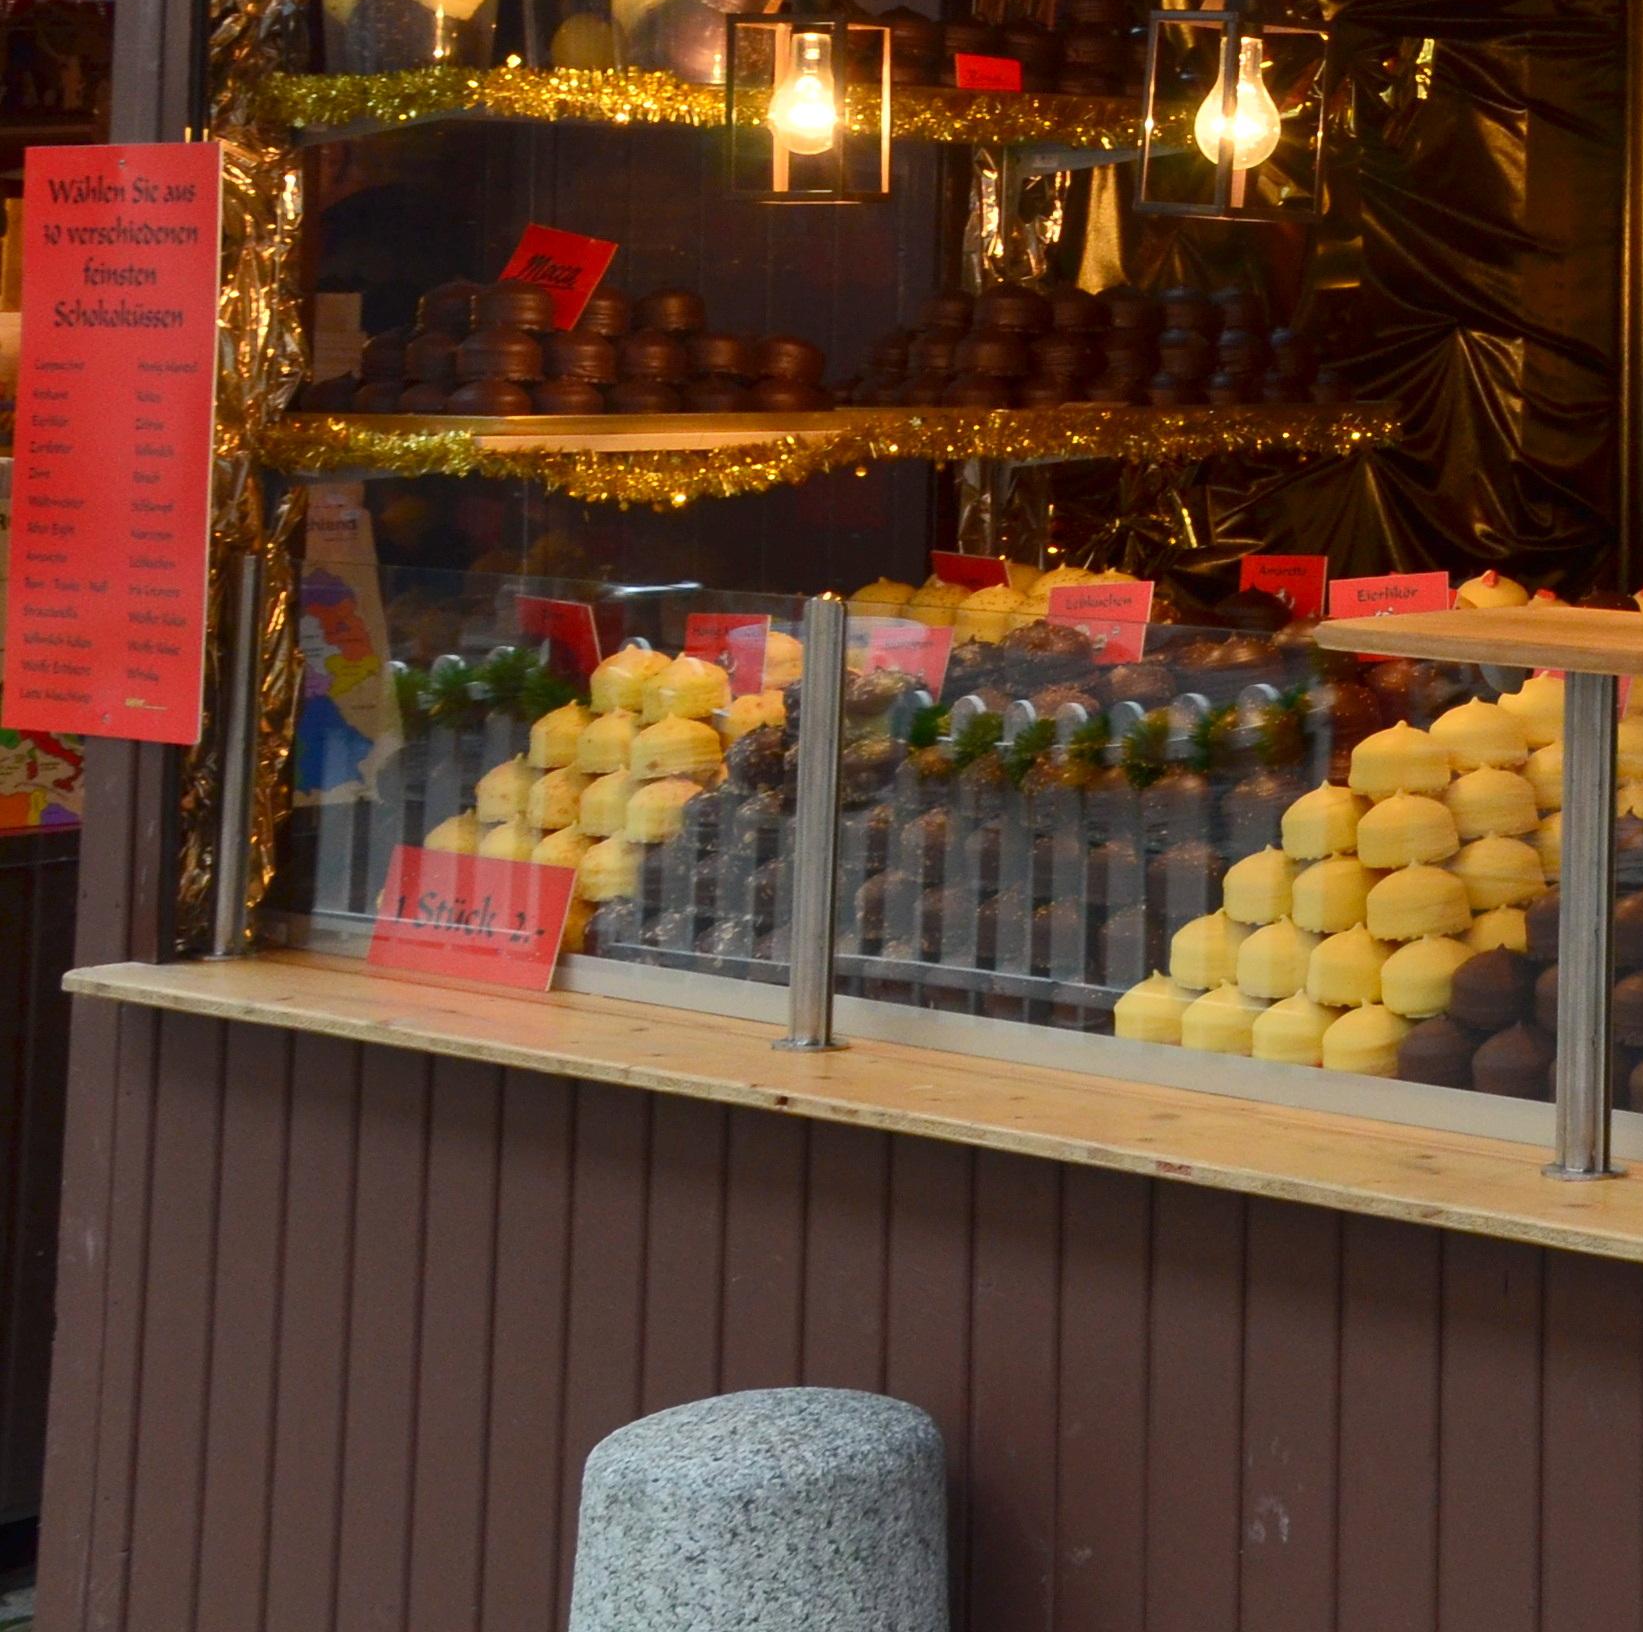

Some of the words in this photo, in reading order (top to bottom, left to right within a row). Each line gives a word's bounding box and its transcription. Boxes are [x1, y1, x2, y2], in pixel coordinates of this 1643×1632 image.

[48, 175, 126, 204] Wählen
[132, 177, 159, 204] Sie
[163, 183, 196, 204] aus
[67, 216, 199, 245] verschiedenen
[83, 256, 157, 287] feinsten
[53, 298, 184, 328] Schokoküssen
[413, 890, 497, 939] Stück
